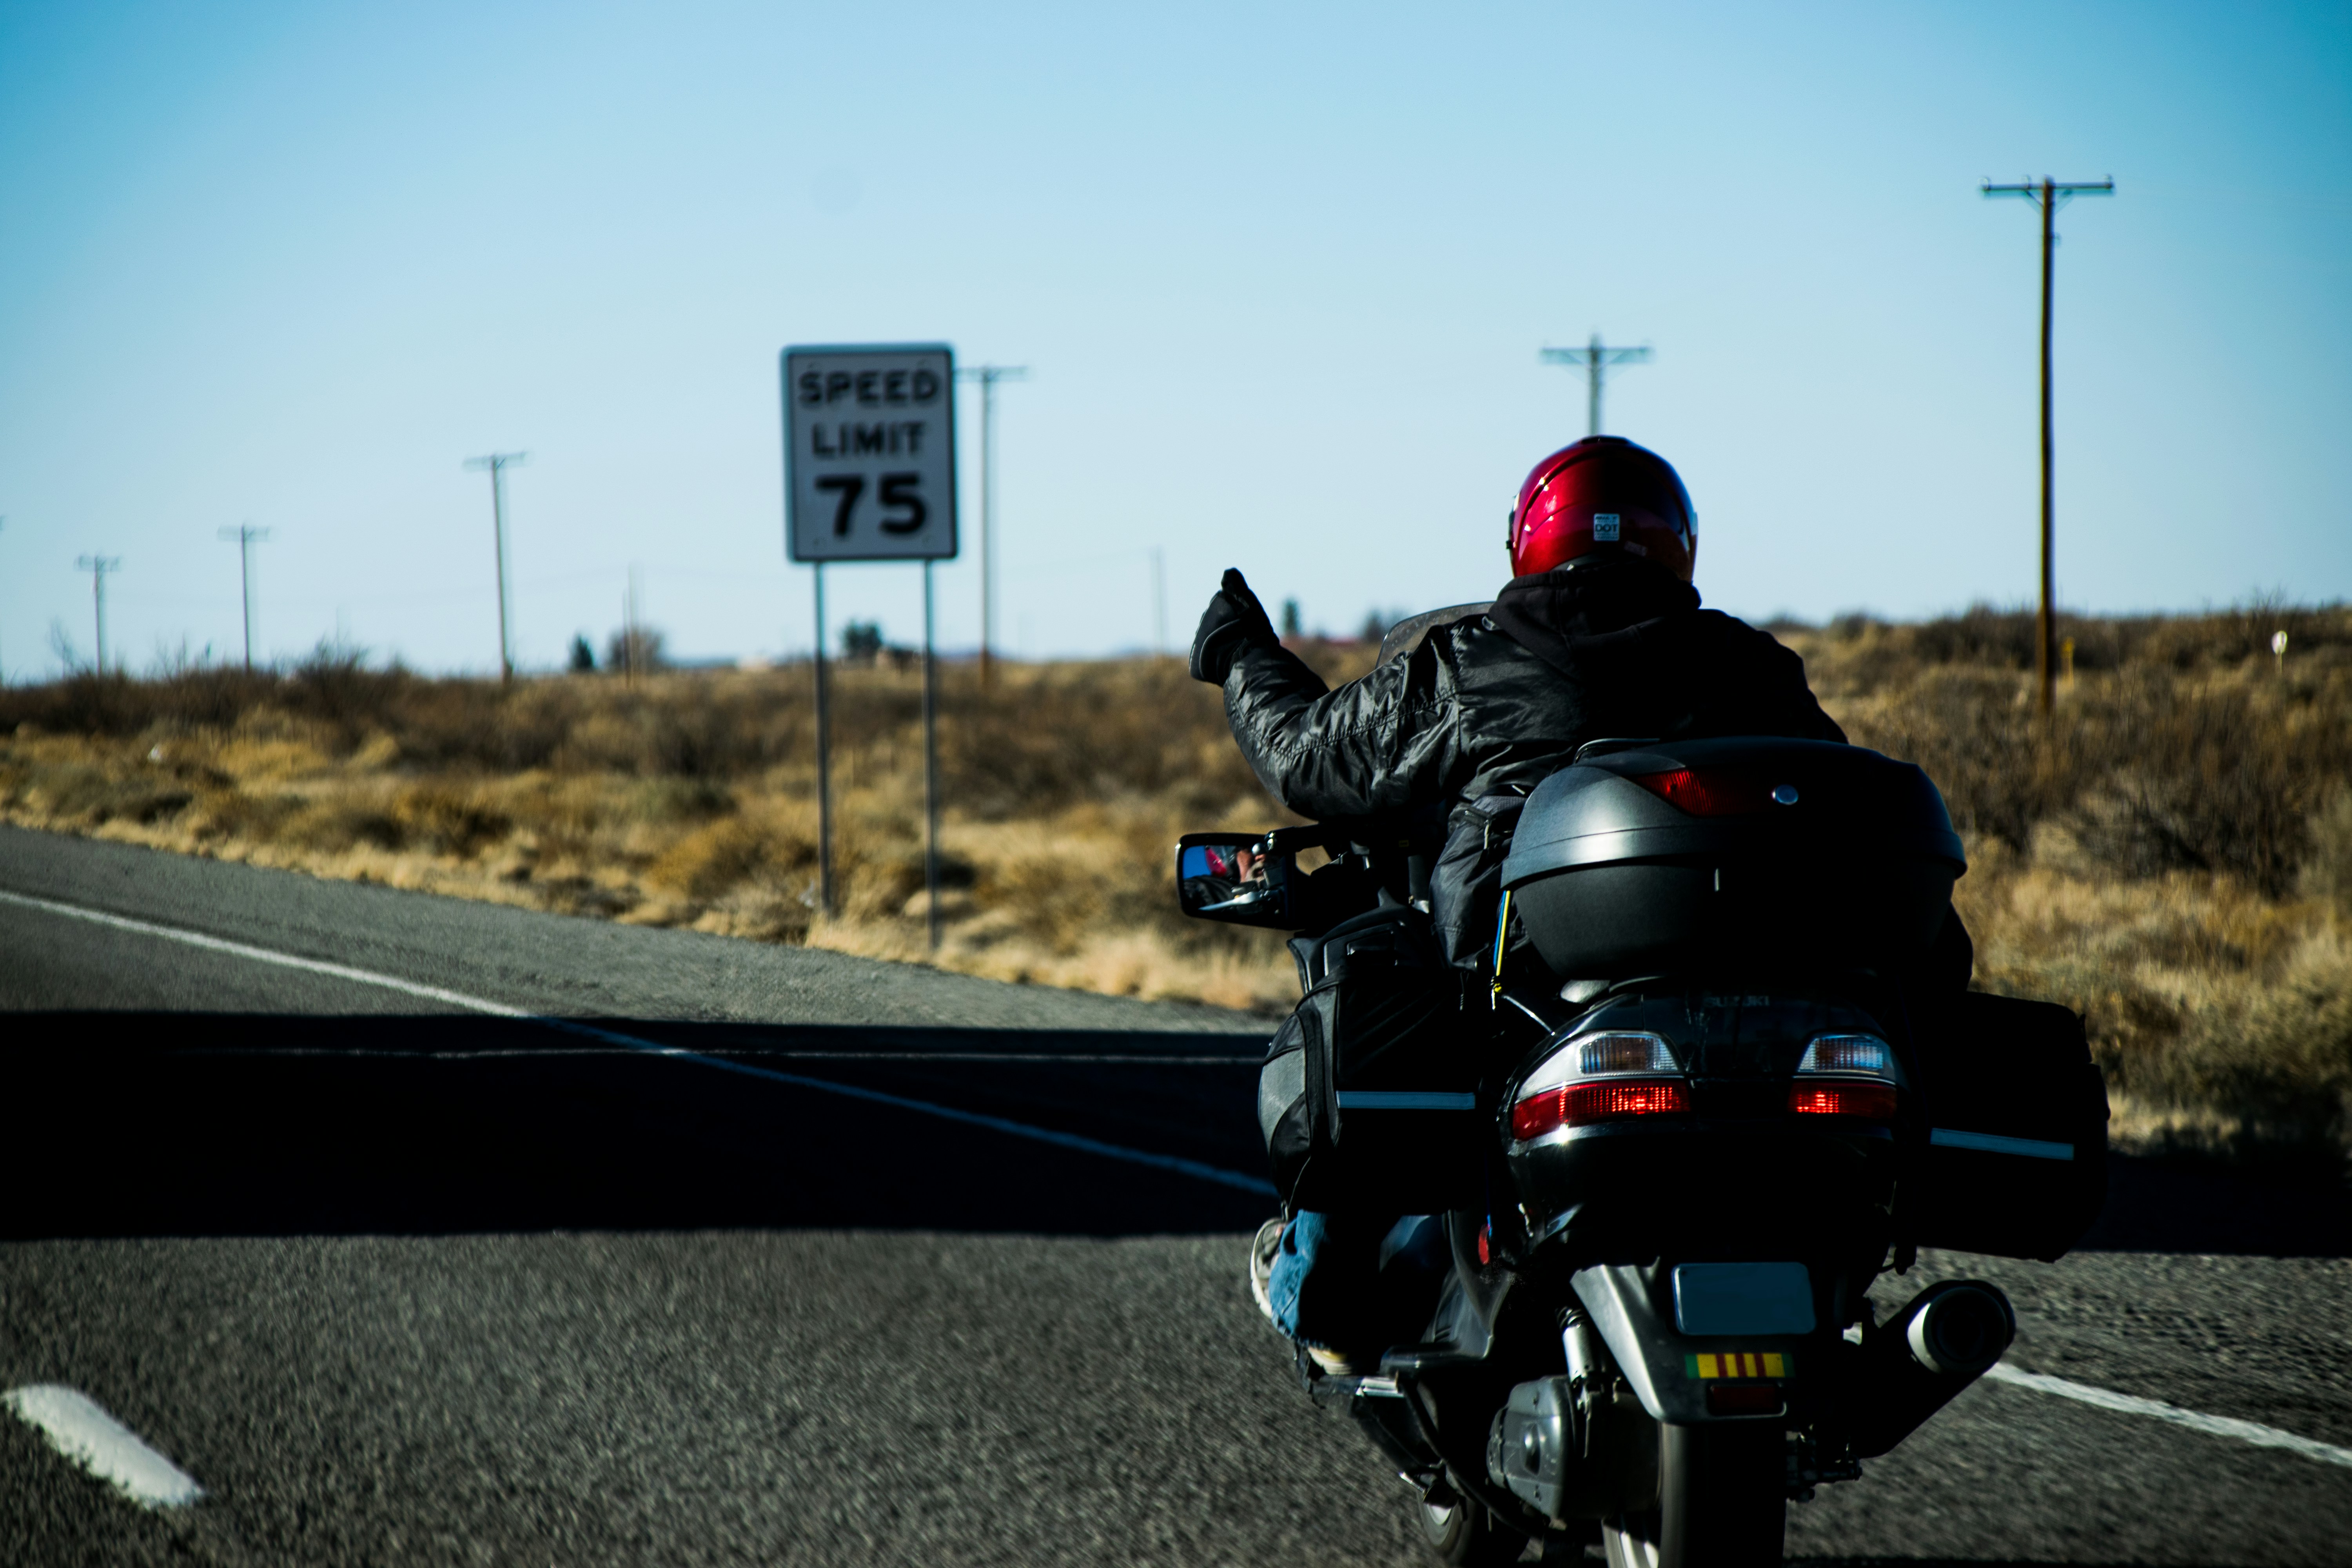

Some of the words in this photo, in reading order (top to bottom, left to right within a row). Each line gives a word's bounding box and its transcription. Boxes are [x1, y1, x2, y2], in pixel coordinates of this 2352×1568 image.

[799, 370, 938, 405] SPEED
[812, 421, 925, 457] LIMIT
[816, 473, 928, 537] 75
[1595, 524, 1618, 532] DOT
[1703, 995, 1770, 1007] SUZUKI
